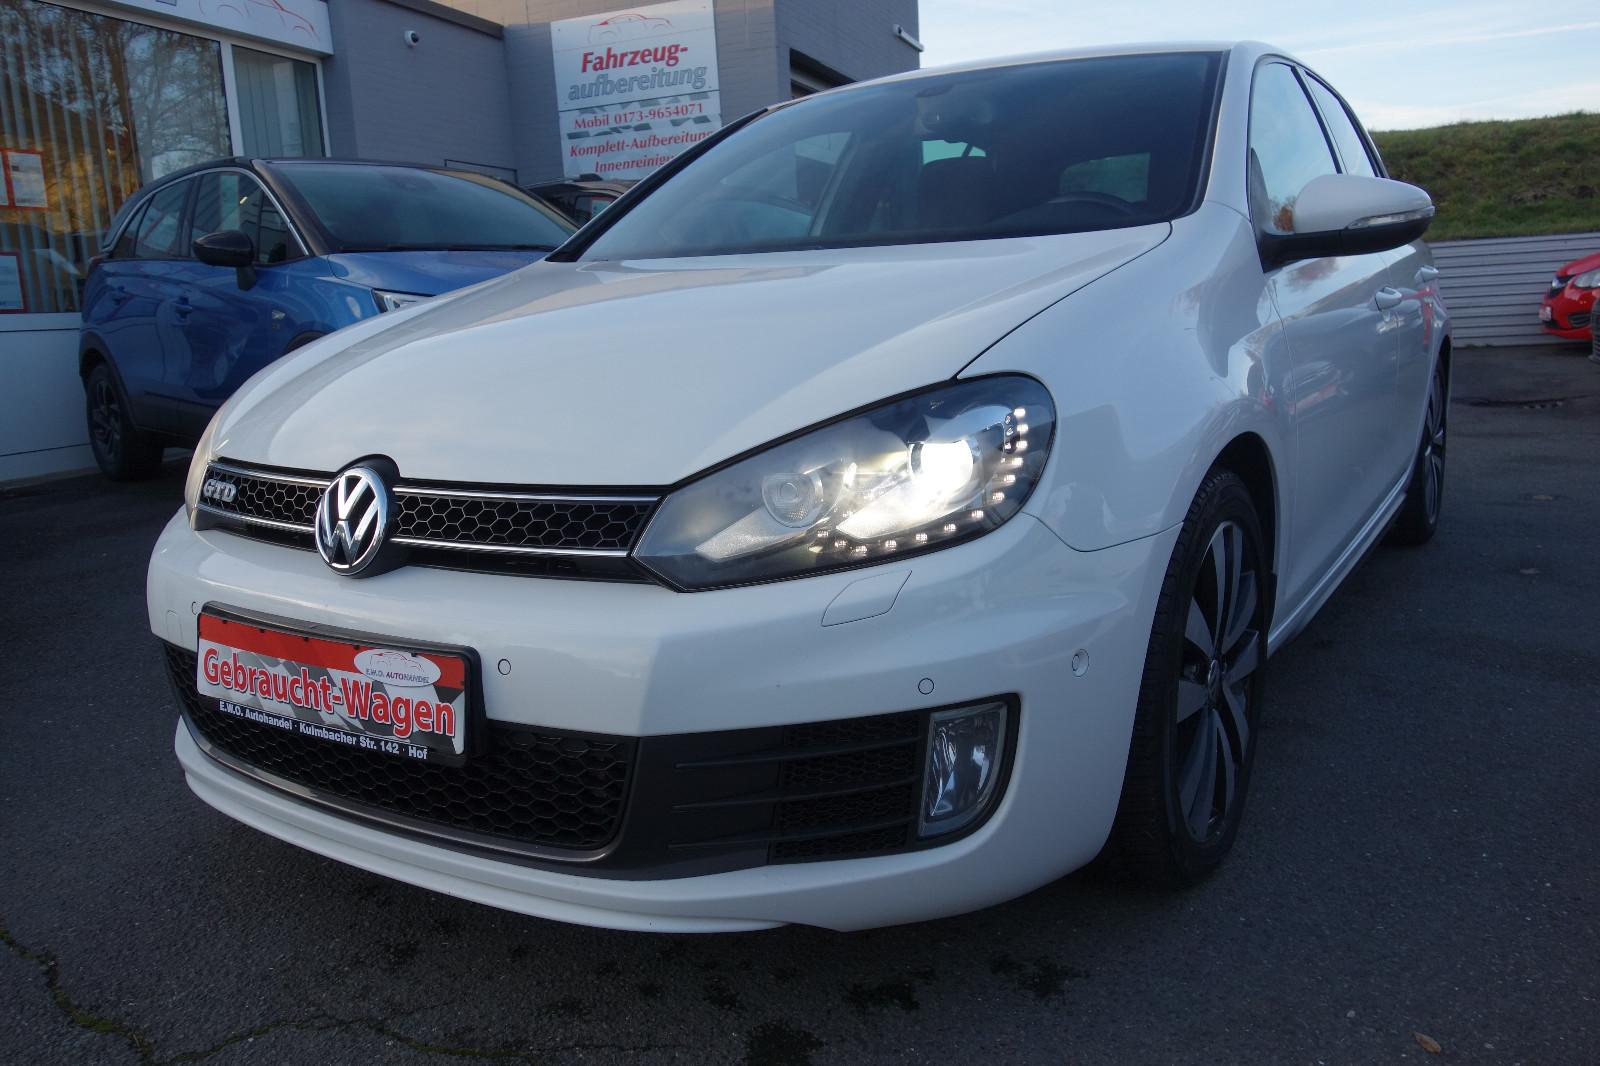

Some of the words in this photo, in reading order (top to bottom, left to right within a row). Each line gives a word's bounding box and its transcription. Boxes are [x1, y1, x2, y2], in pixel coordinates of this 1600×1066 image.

[581, 44, 688, 73] Fahrzeug-
[568, 66, 708, 101] aufbereitung
[574, 114, 609, 129] Mobil
[614, 103, 704, 124] 0173-9654071
[203, 478, 237, 502] GTD
[386, 671, 430, 684] AUTOHANDEL
[202, 647, 456, 739] Gebraucht-Wagen
[219, 700, 244, 717] E.W.O.
[245, 707, 293, 730] Autohandel
[299, 722, 357, 745] Kulmbacher
[360, 735, 377, 750] Str.
[380, 740, 400, 755] 142
[408, 745, 428, 760] Hof
